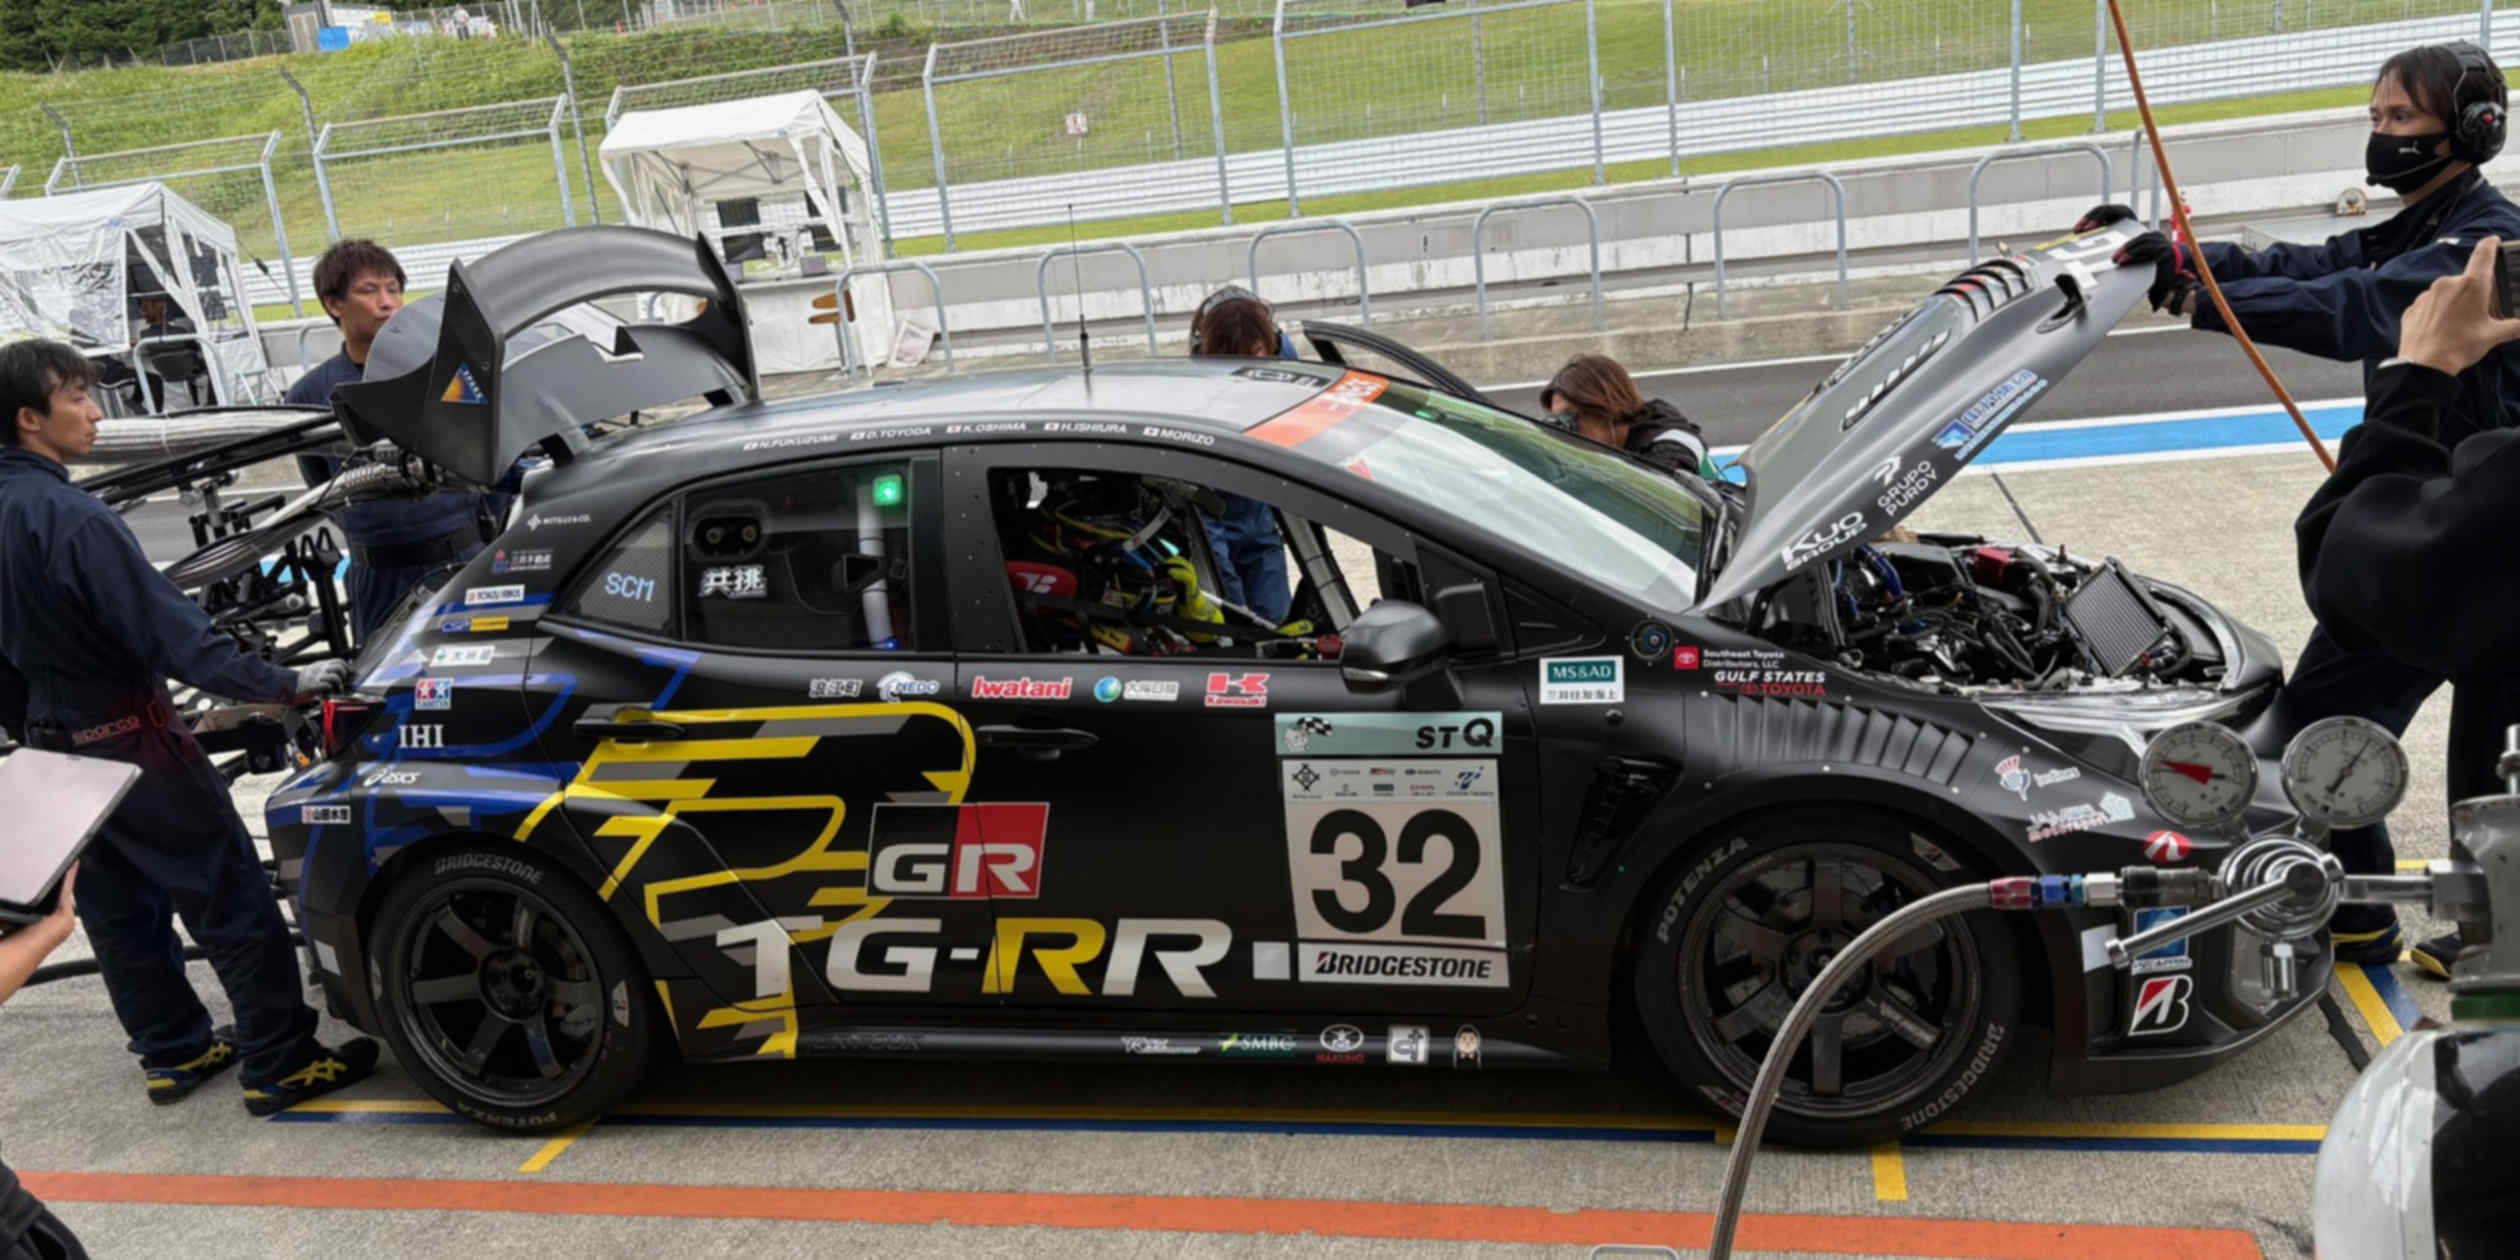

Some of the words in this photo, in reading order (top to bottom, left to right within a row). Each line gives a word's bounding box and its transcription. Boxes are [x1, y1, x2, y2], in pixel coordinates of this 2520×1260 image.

[1160, 427, 1215, 446] MORIZO
[1877, 460, 1931, 508] GRUPO
[1885, 468, 1937, 517] PURDY
[1781, 511, 1864, 565] KUO
[604, 572, 655, 601] SCM
[1702, 649, 1750, 659] Southeast
[1752, 650, 1785, 660] Toyota
[1762, 660, 1780, 668] LLC
[1552, 665, 1613, 679] MS&AD
[1714, 671, 1760, 683] GULF
[1763, 671, 1826, 683] STATES
[971, 676, 1073, 700] Iwatani
[1760, 684, 1827, 696] TOYOTA
[1205, 696, 1267, 706] Kawasaki
[398, 724, 444, 748] IHI
[434, 853, 545, 885] BRIDGESTONE
[873, 843, 1036, 893] GR
[1310, 809, 1486, 940] 32
[1656, 836, 1749, 944] POTENZA
[1316, 952, 1492, 979] BRIDGESTONE
[1240, 1036, 1297, 1051] SMBC
[1902, 1022, 2005, 1131] BRIDGESTONE
